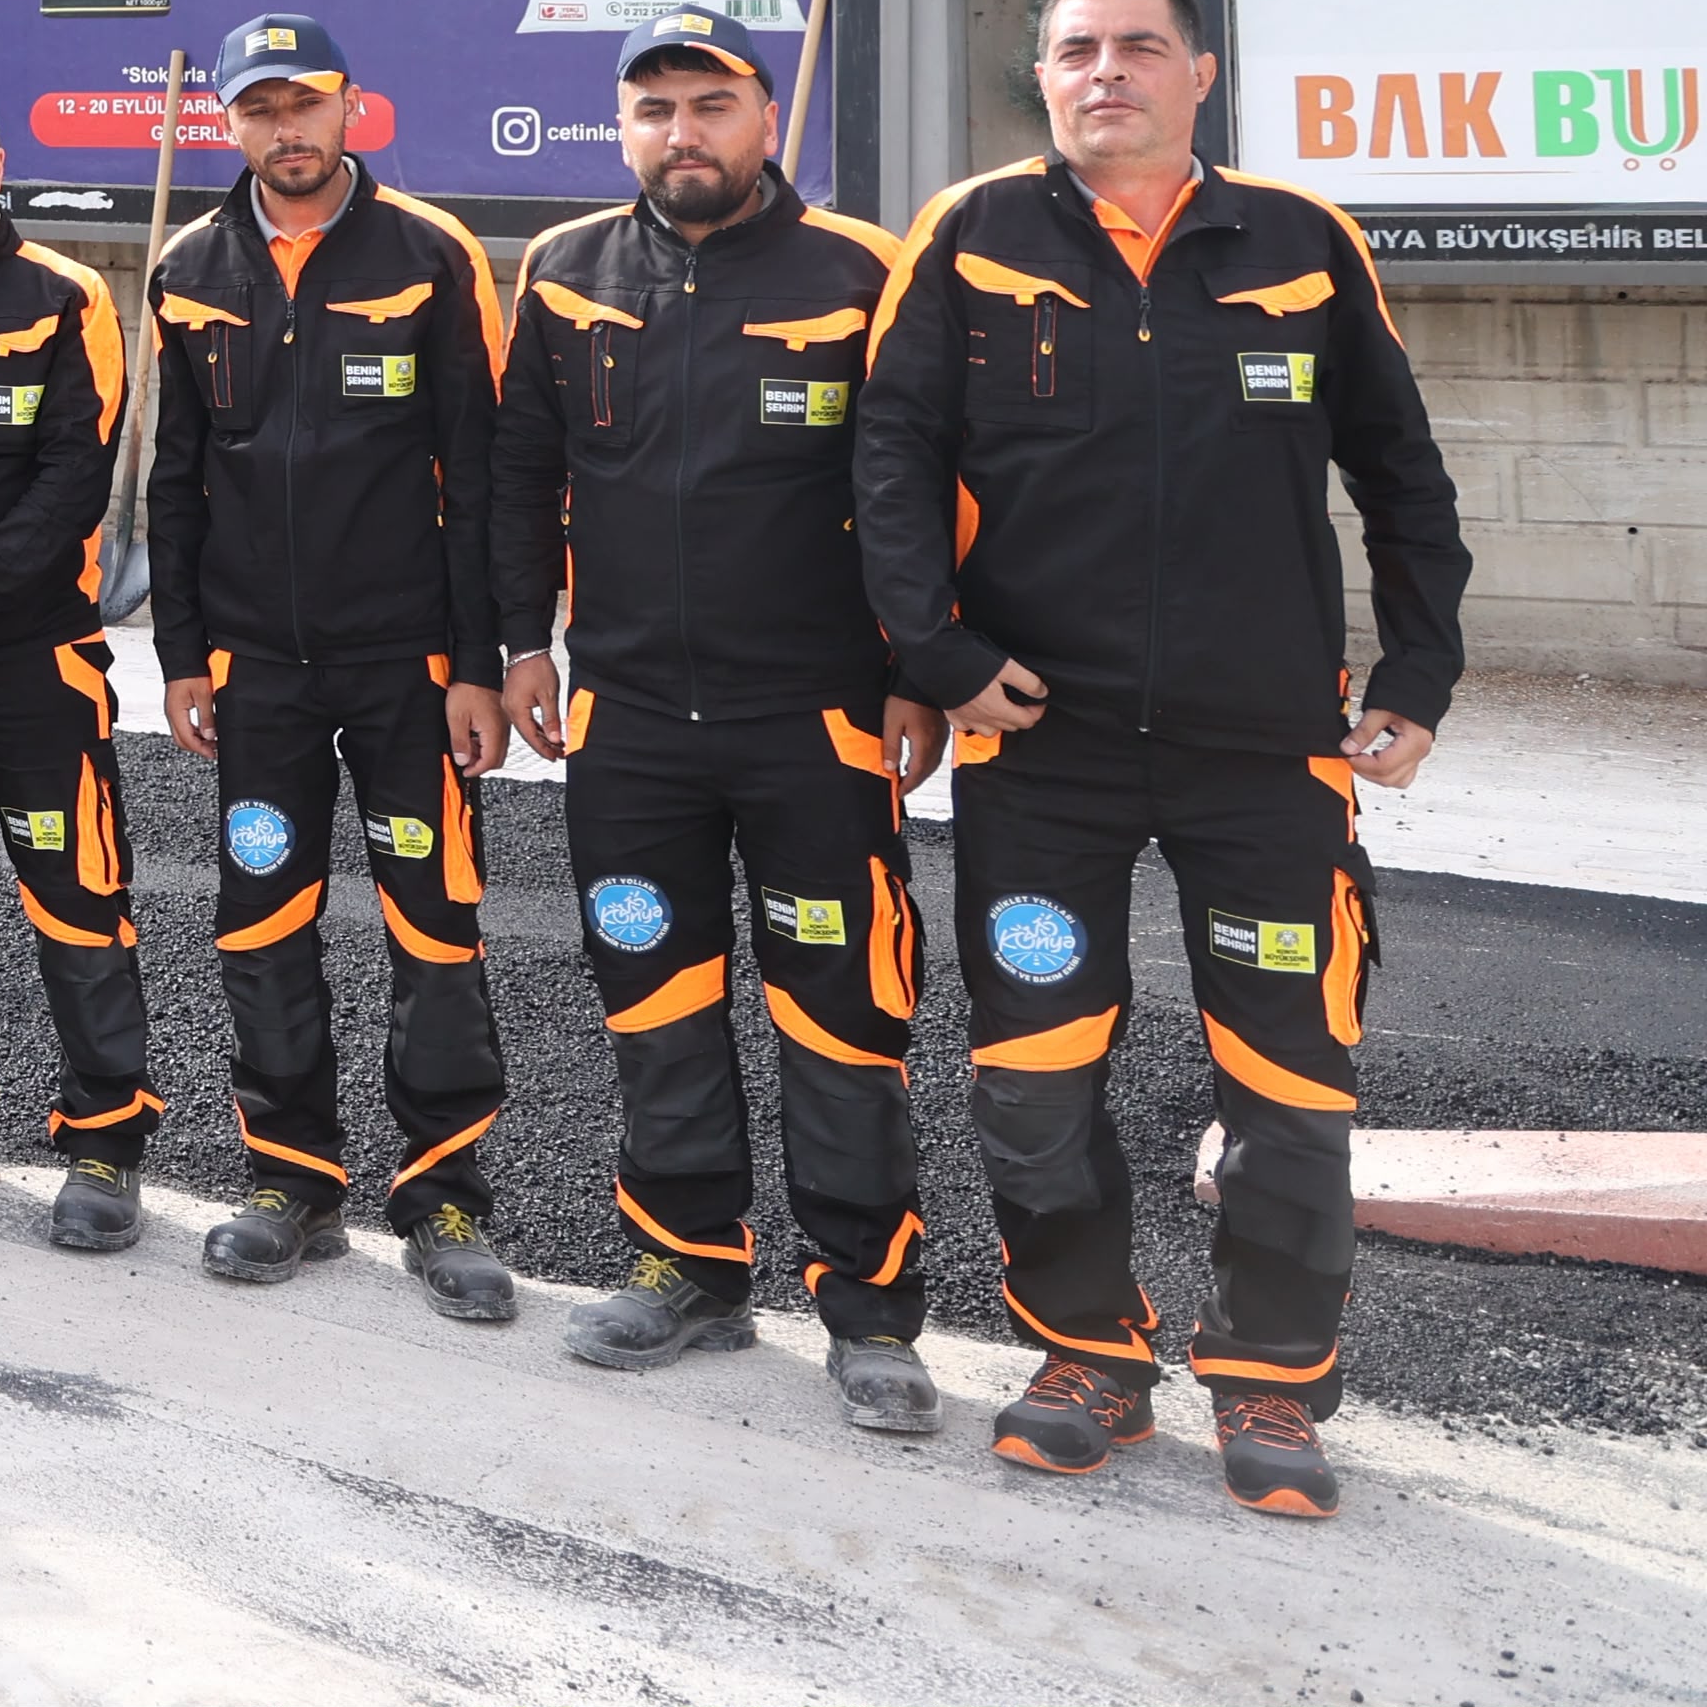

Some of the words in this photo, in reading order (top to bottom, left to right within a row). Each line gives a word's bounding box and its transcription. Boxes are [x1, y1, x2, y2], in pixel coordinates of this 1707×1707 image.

[57, 98, 76, 115] 12
[89, 98, 108, 115] 20
[112, 96, 166, 115] EYLÜL
[1294, 71, 1507, 159] BAK
[1369, 227, 1427, 250] NYA
[1436, 223, 1643, 254] BÜYÜKŞEHİR
[1652, 228, 1707, 250] BEL
[346, 365, 382, 376] BENİM
[1245, 364, 1289, 377] BENİM
[346, 376, 382, 387] ŞEHRİM
[1247, 377, 1290, 390] ŞEHRİM
[765, 390, 806, 403] BENİM
[765, 402, 805, 414] ŞEHRİM
[600, 905, 663, 928] Konya
[998, 927, 1076, 954] Konya
[1213, 921, 1256, 943] BENİM
[1213, 934, 1256, 954] ŞEHRİM
